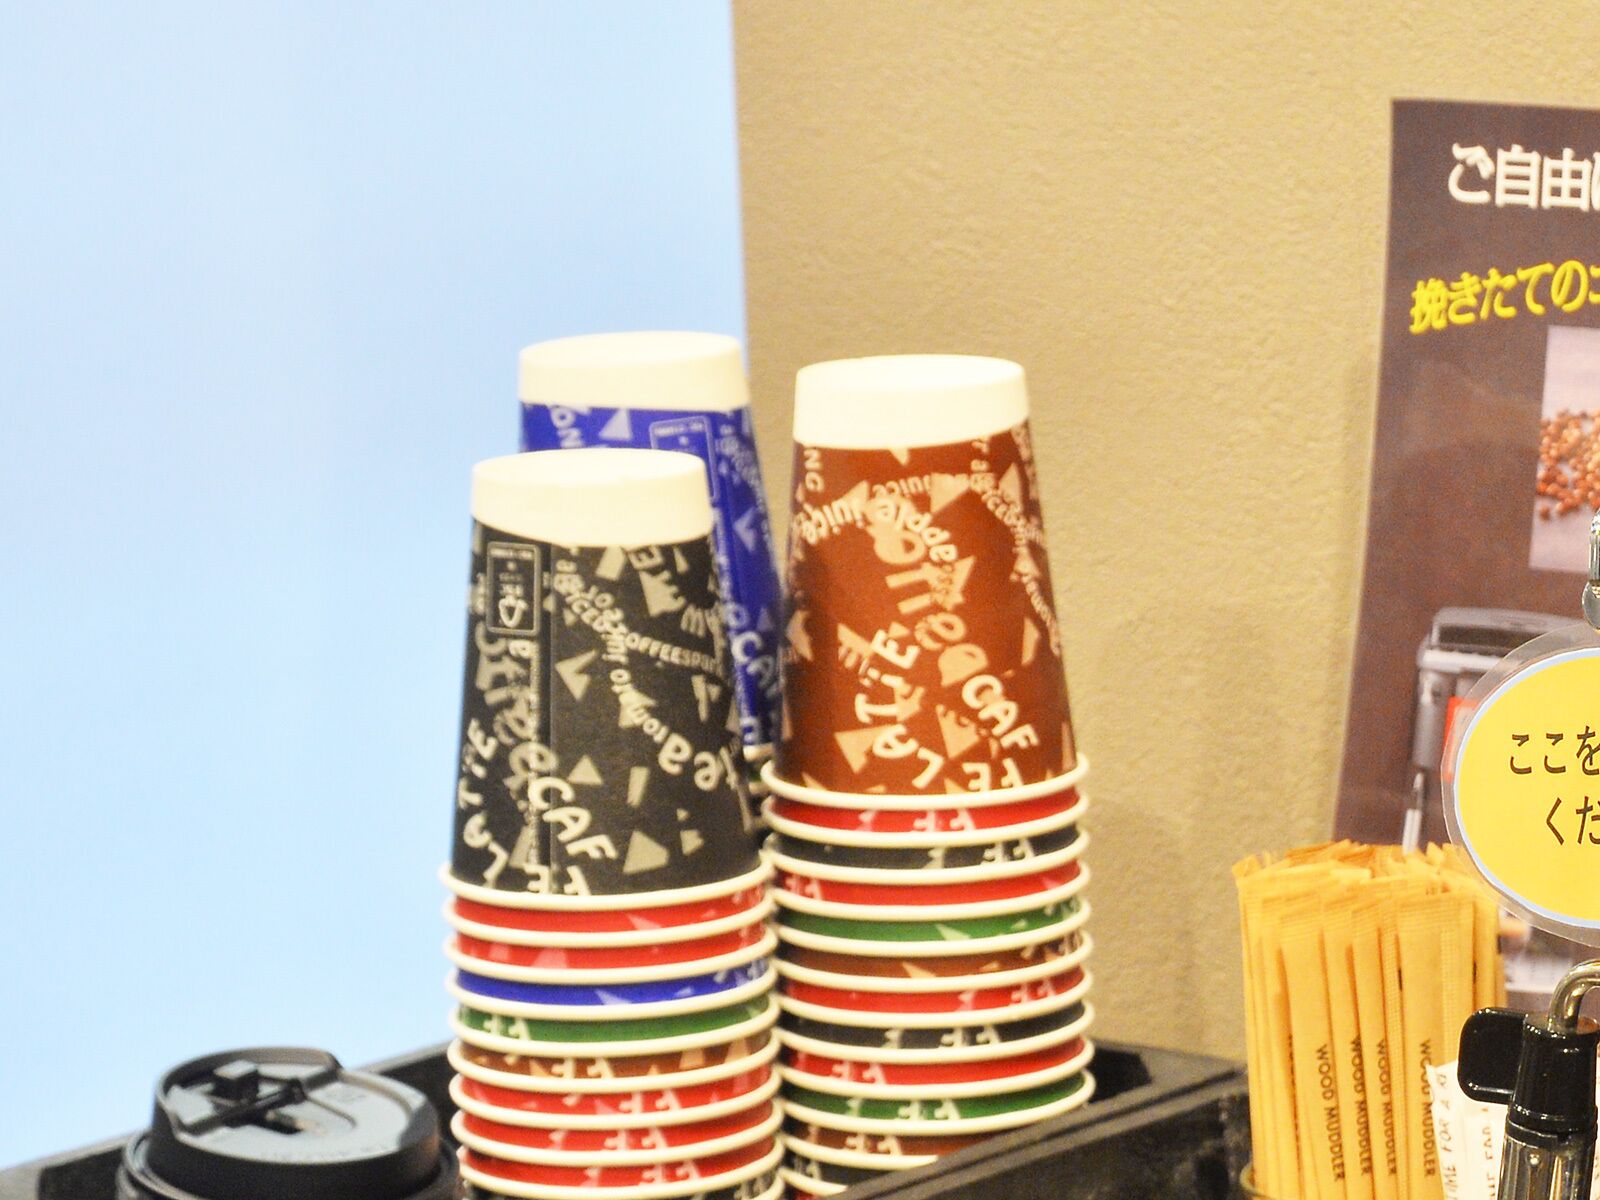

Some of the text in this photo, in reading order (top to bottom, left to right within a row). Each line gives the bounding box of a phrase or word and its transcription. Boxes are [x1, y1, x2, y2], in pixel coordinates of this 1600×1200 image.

[1316, 1043, 1346, 1182] WOOD MUDDLER
[1351, 1034, 1373, 1176] WOOD MUDDLER
[1376, 1039, 1397, 1177] WOOD MUDDLER
[1422, 1101, 1436, 1178] MUDDLER
